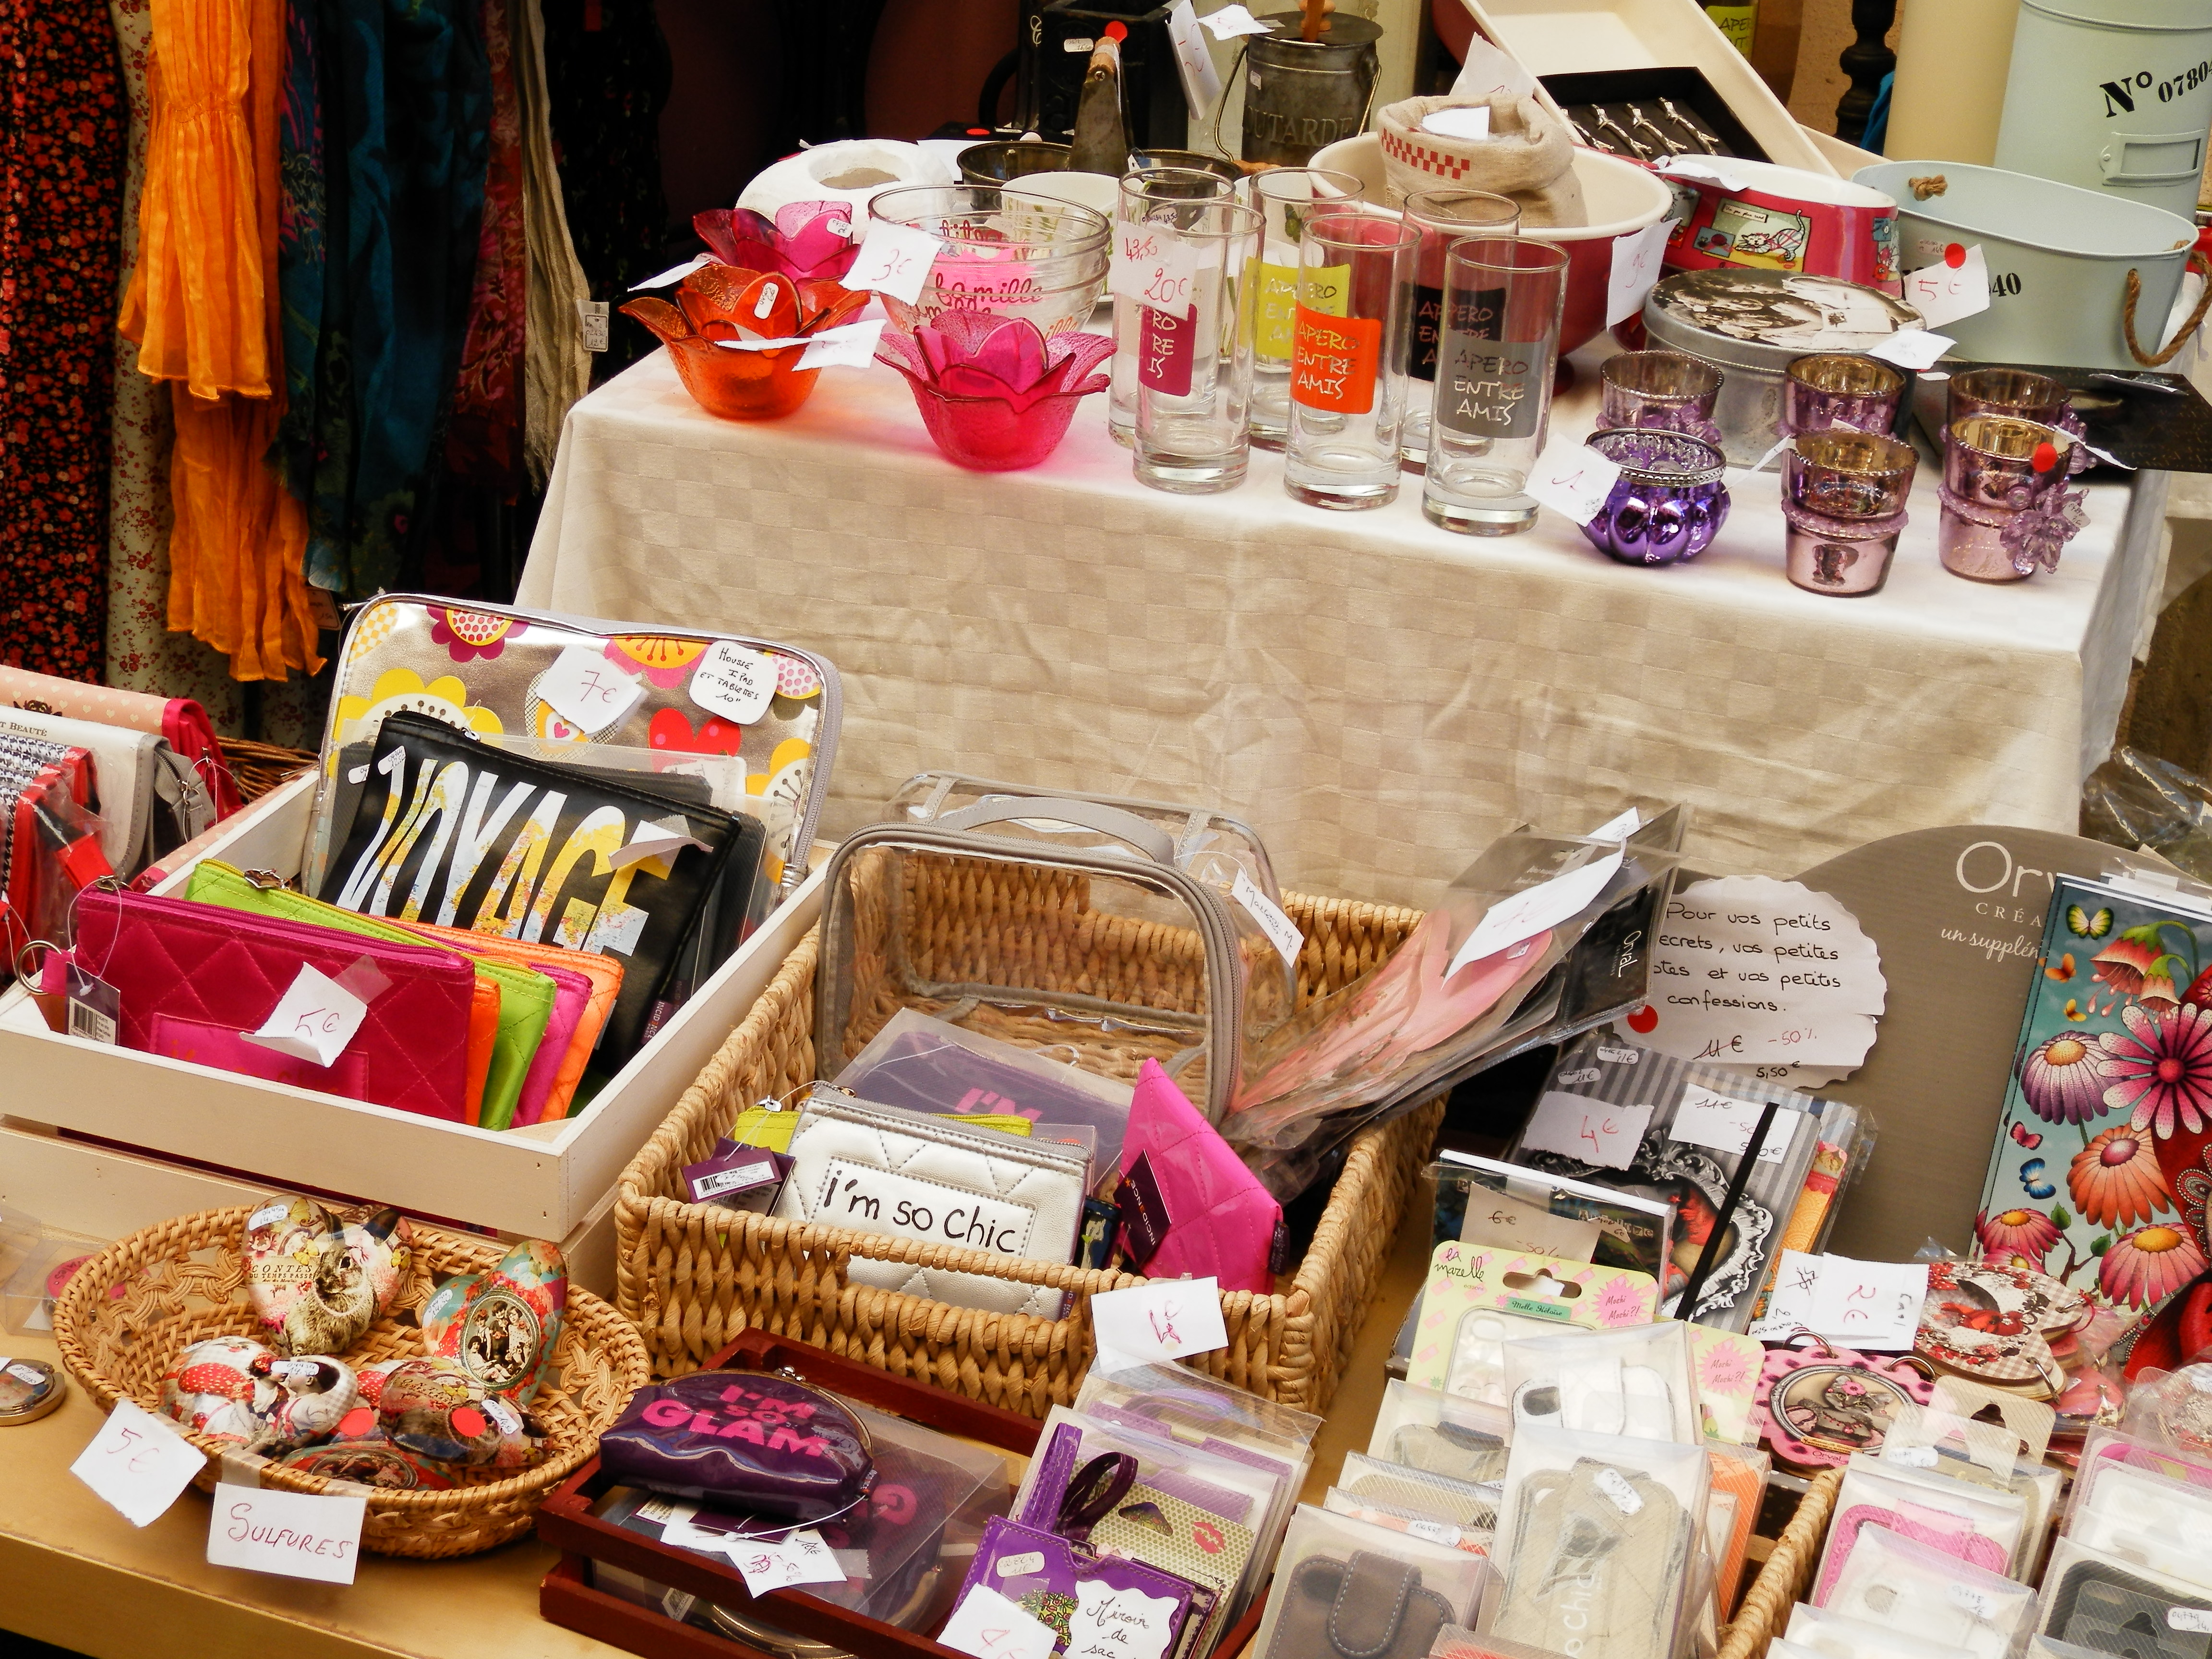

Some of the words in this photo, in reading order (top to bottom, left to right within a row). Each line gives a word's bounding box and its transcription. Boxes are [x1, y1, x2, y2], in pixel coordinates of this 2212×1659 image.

[871, 249, 912, 281] 3€
[1918, 268, 1962, 301] 5€
[1299, 321, 1360, 350] APERO
[1298, 346, 1357, 376] ENTRE
[1455, 349, 1529, 376] APERO
[1298, 370, 1347, 400] AMIS
[1454, 375, 1525, 401] ENTRE
[1456, 398, 1515, 426] AMIS
[581, 670, 617, 703] 7€
[700, 672, 715, 680] ET
[336, 758, 672, 958] VOYAGE
[1666, 902, 1717, 920] Pour
[1728, 913, 1761, 925] vos
[1773, 913, 1831, 936] petits
[1941, 928, 1967, 942] un
[1733, 944, 1763, 955] vos
[1773, 943, 1839, 963] petites
[1707, 968, 1728, 979] et
[1739, 972, 1770, 982] vos
[1780, 971, 1841, 991] petites
[1667, 989, 1787, 1011] confessions.
[294, 1008, 340, 1037] 5€
[1580, 1115, 1619, 1154] 4€
[1130, 1179, 1156, 1246] INCIDENCE
[943, 1205, 1016, 1254] Chic
[252, 1264, 313, 1273] CONTES
[1605, 1296, 1626, 1306] Moshi
[642, 1399, 830, 1457] GLAM
[107, 1428, 160, 1473] 5€
[228, 1503, 353, 1559] SULFURES
